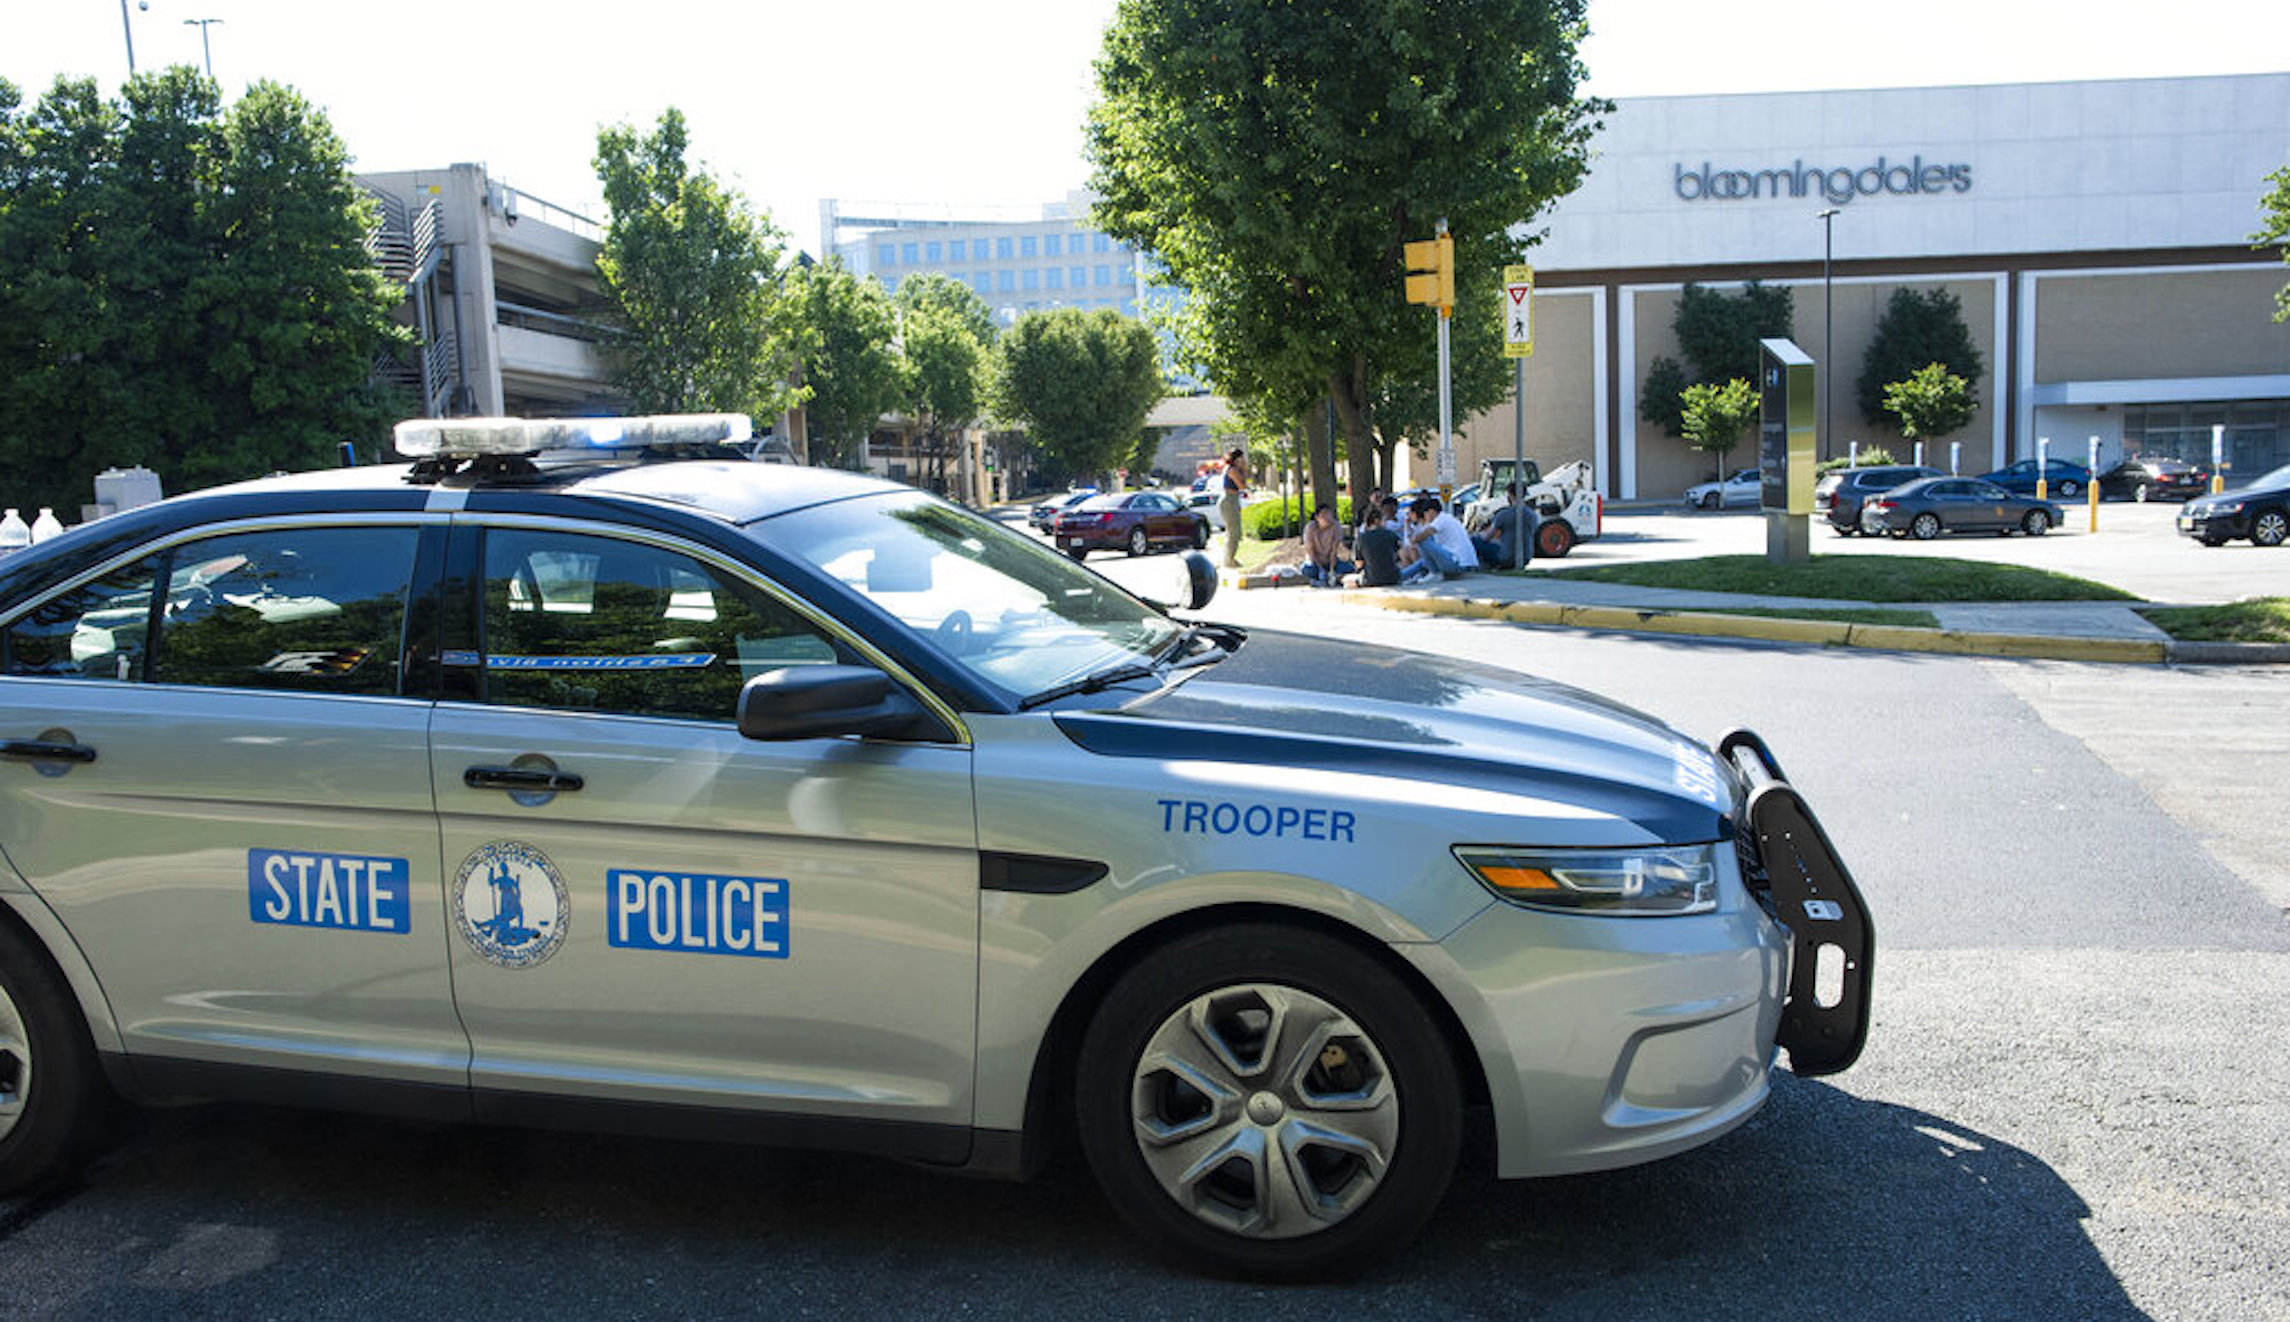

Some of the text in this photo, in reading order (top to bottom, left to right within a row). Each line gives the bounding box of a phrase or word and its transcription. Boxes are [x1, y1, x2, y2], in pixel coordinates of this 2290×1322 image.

[1675, 155, 1972, 205] bloomingdale's
[1157, 800, 1356, 843] TROOPER
[264, 855, 395, 929] STATE
[618, 873, 780, 951] POLICE
